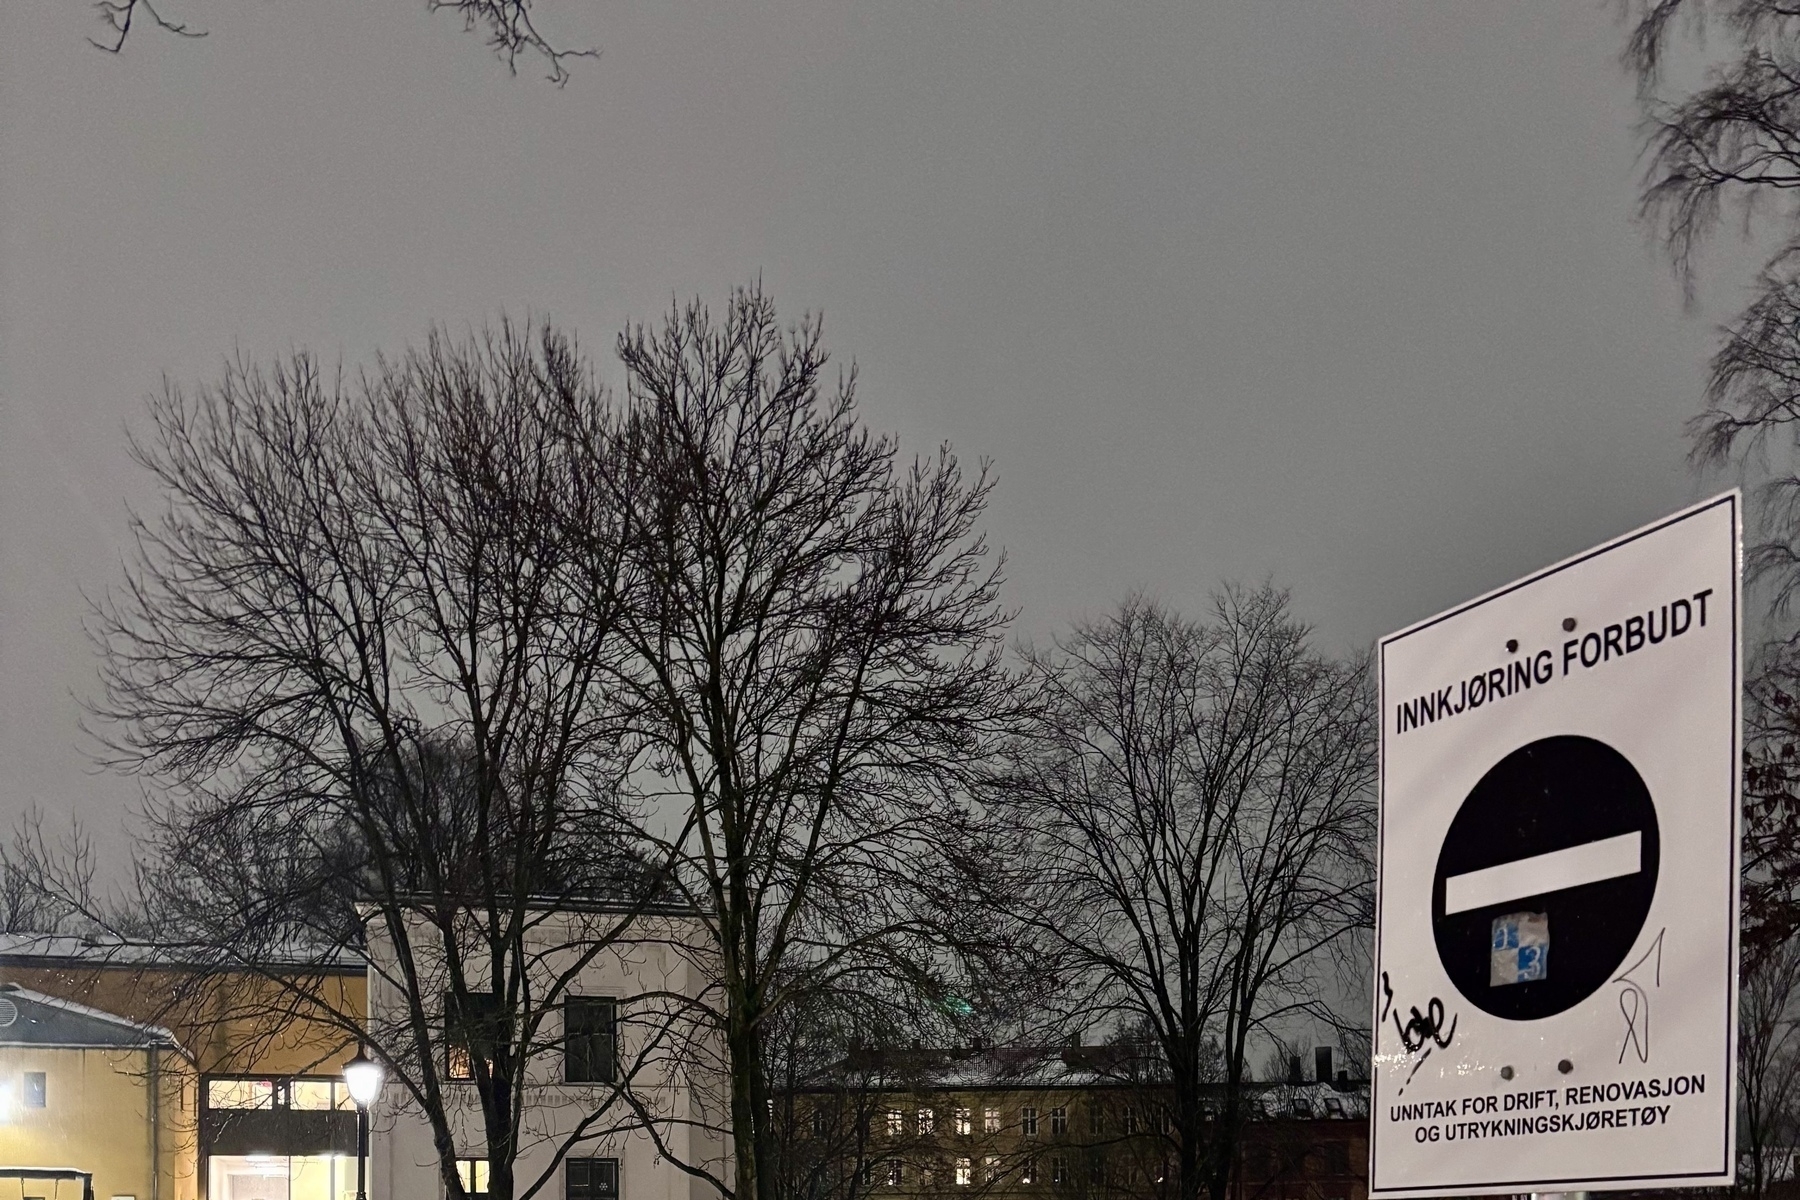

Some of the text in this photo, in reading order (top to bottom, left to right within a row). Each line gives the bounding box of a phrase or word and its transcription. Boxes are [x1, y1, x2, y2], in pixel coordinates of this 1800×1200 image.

[1396, 588, 1714, 735] INNKJØRING FORBUDT
[1390, 1073, 1706, 1122] UNNTAK FOR DRIFT, RENOVASJON
[1414, 1104, 1671, 1144] OG UTRYKNINGSKJØRETØY
